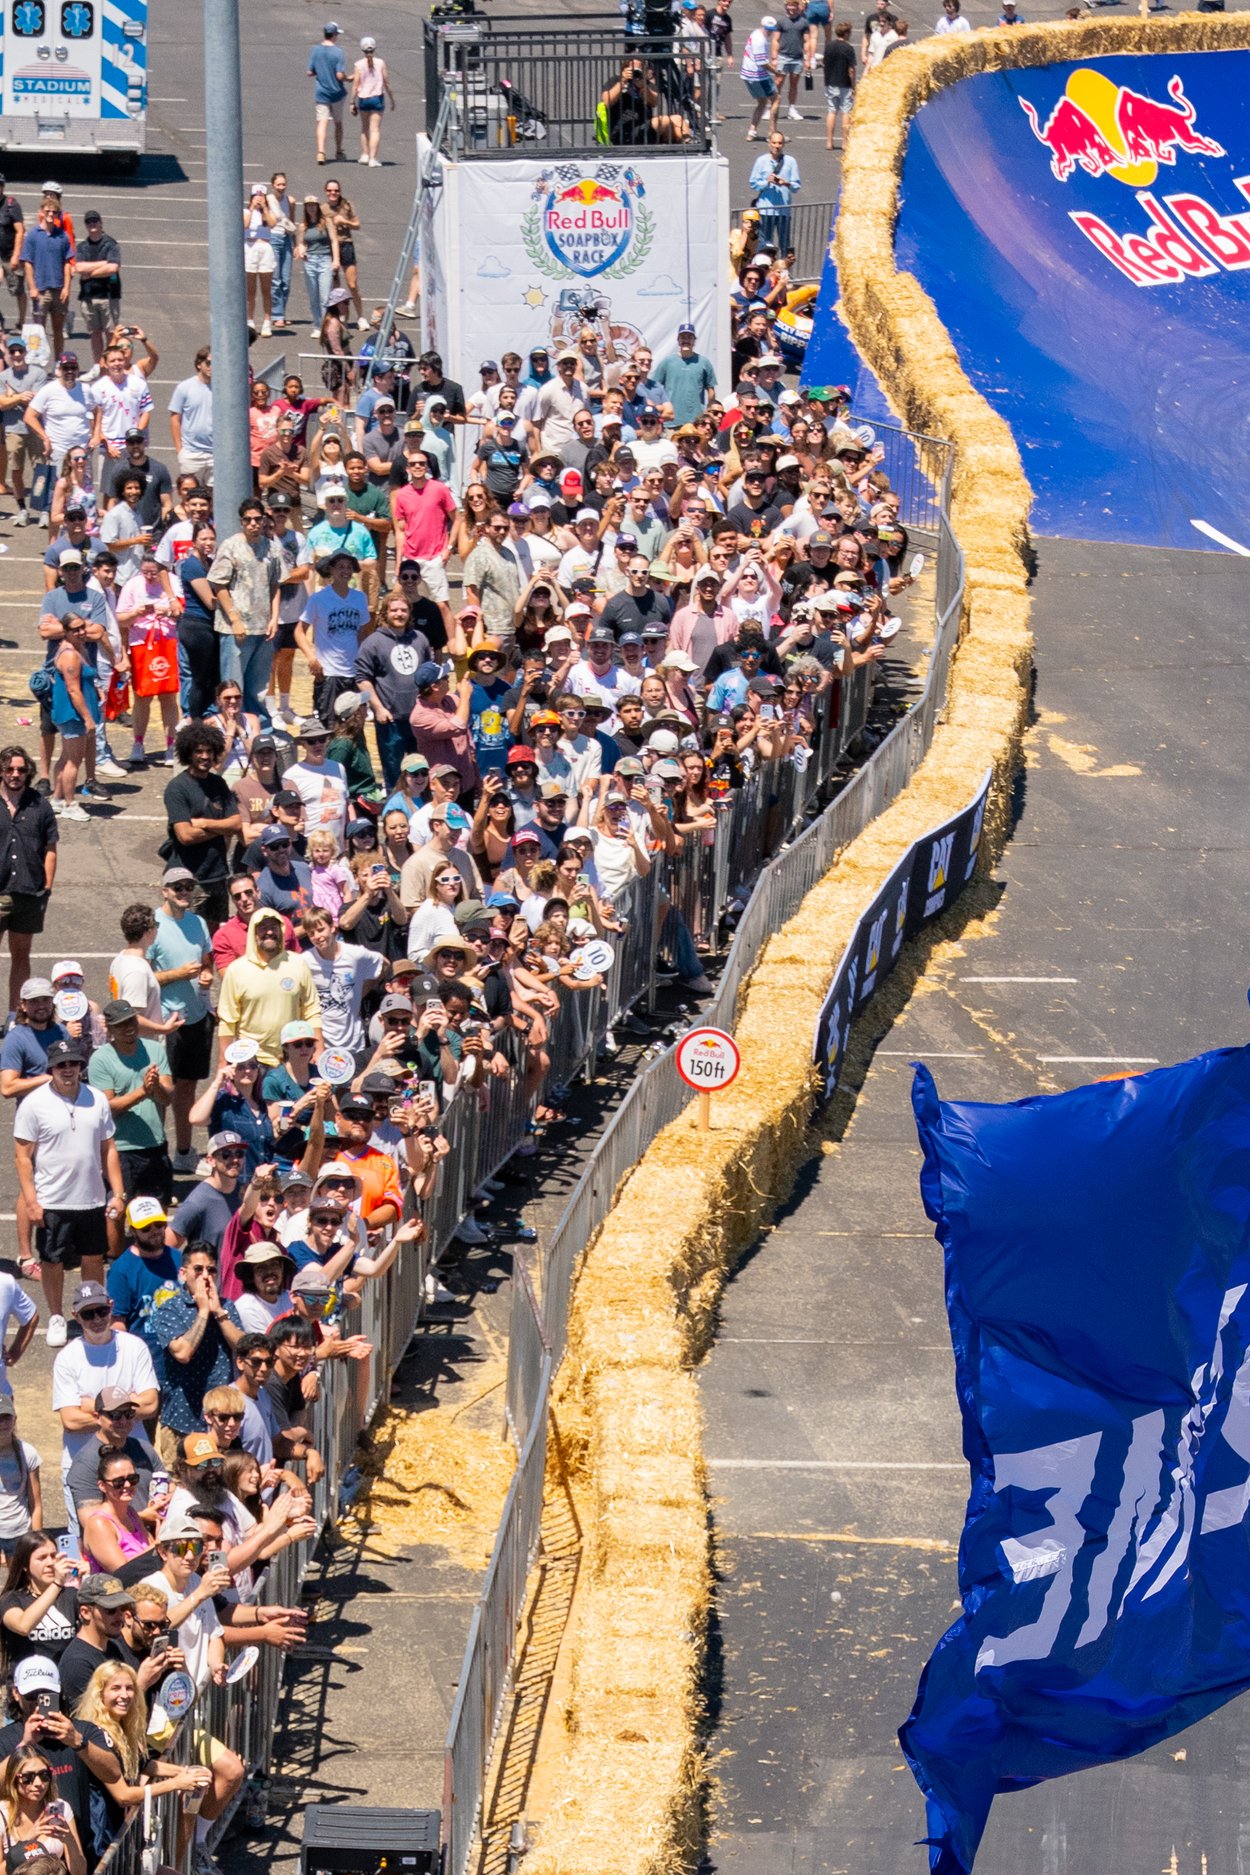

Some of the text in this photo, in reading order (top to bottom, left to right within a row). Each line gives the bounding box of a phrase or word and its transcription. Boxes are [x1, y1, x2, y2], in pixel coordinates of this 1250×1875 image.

[14, 79, 90, 92] STADIUM
[548, 209, 629, 229] Red Bull
[558, 230, 619, 248] SOAPBOX
[1076, 197, 1209, 282] Red
[573, 250, 605, 264] RACE
[588, 947, 607, 966] 10
[693, 1048, 725, 1059] Red Bull
